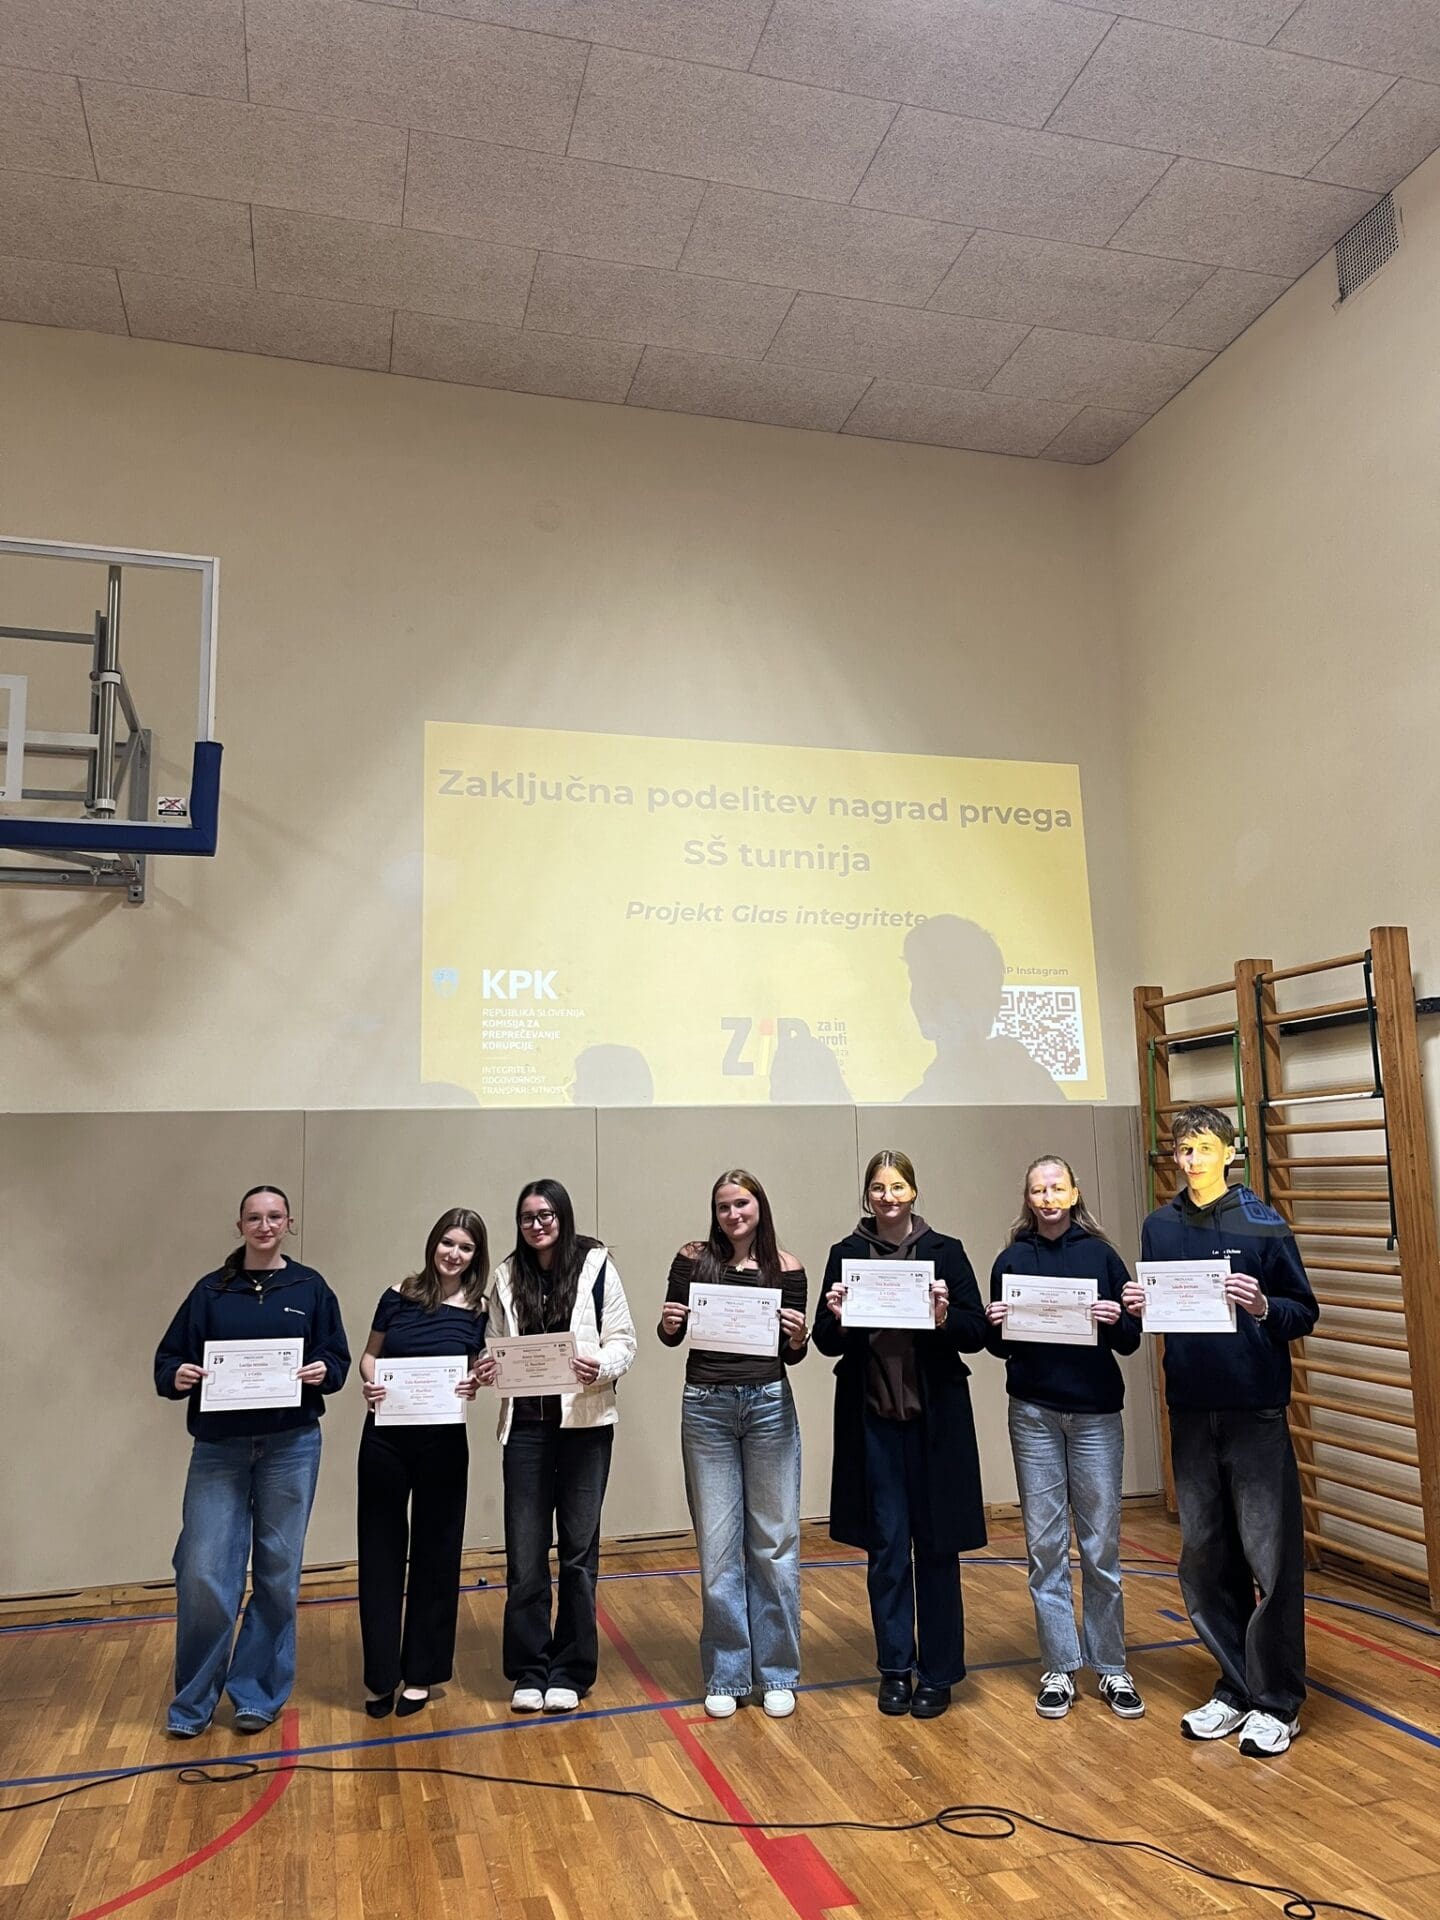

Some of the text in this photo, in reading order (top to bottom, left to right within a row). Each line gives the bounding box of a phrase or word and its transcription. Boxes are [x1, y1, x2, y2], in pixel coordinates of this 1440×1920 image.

[437, 768, 1073, 833] Zaključna podelitev nagrad prvega
[683, 833, 872, 878] SŠ turnirja
[624, 900, 930, 931] Projekt Glas integritete
[1016, 966, 1069, 977] Instagram
[481, 968, 560, 1001] KPK
[481, 1007, 586, 1018] REPUBLIKA SLOVENIJA
[481, 1018, 541, 1029] KOMISIJA ZA
[816, 1017, 846, 1032] za in
[481, 1028, 562, 1040] PREPREČEVANJE
[481, 1040, 536, 1051] KORUPCIJE
[481, 1065, 538, 1075] INTEGRITETA
[481, 1075, 546, 1085] ODGOVORNOST
